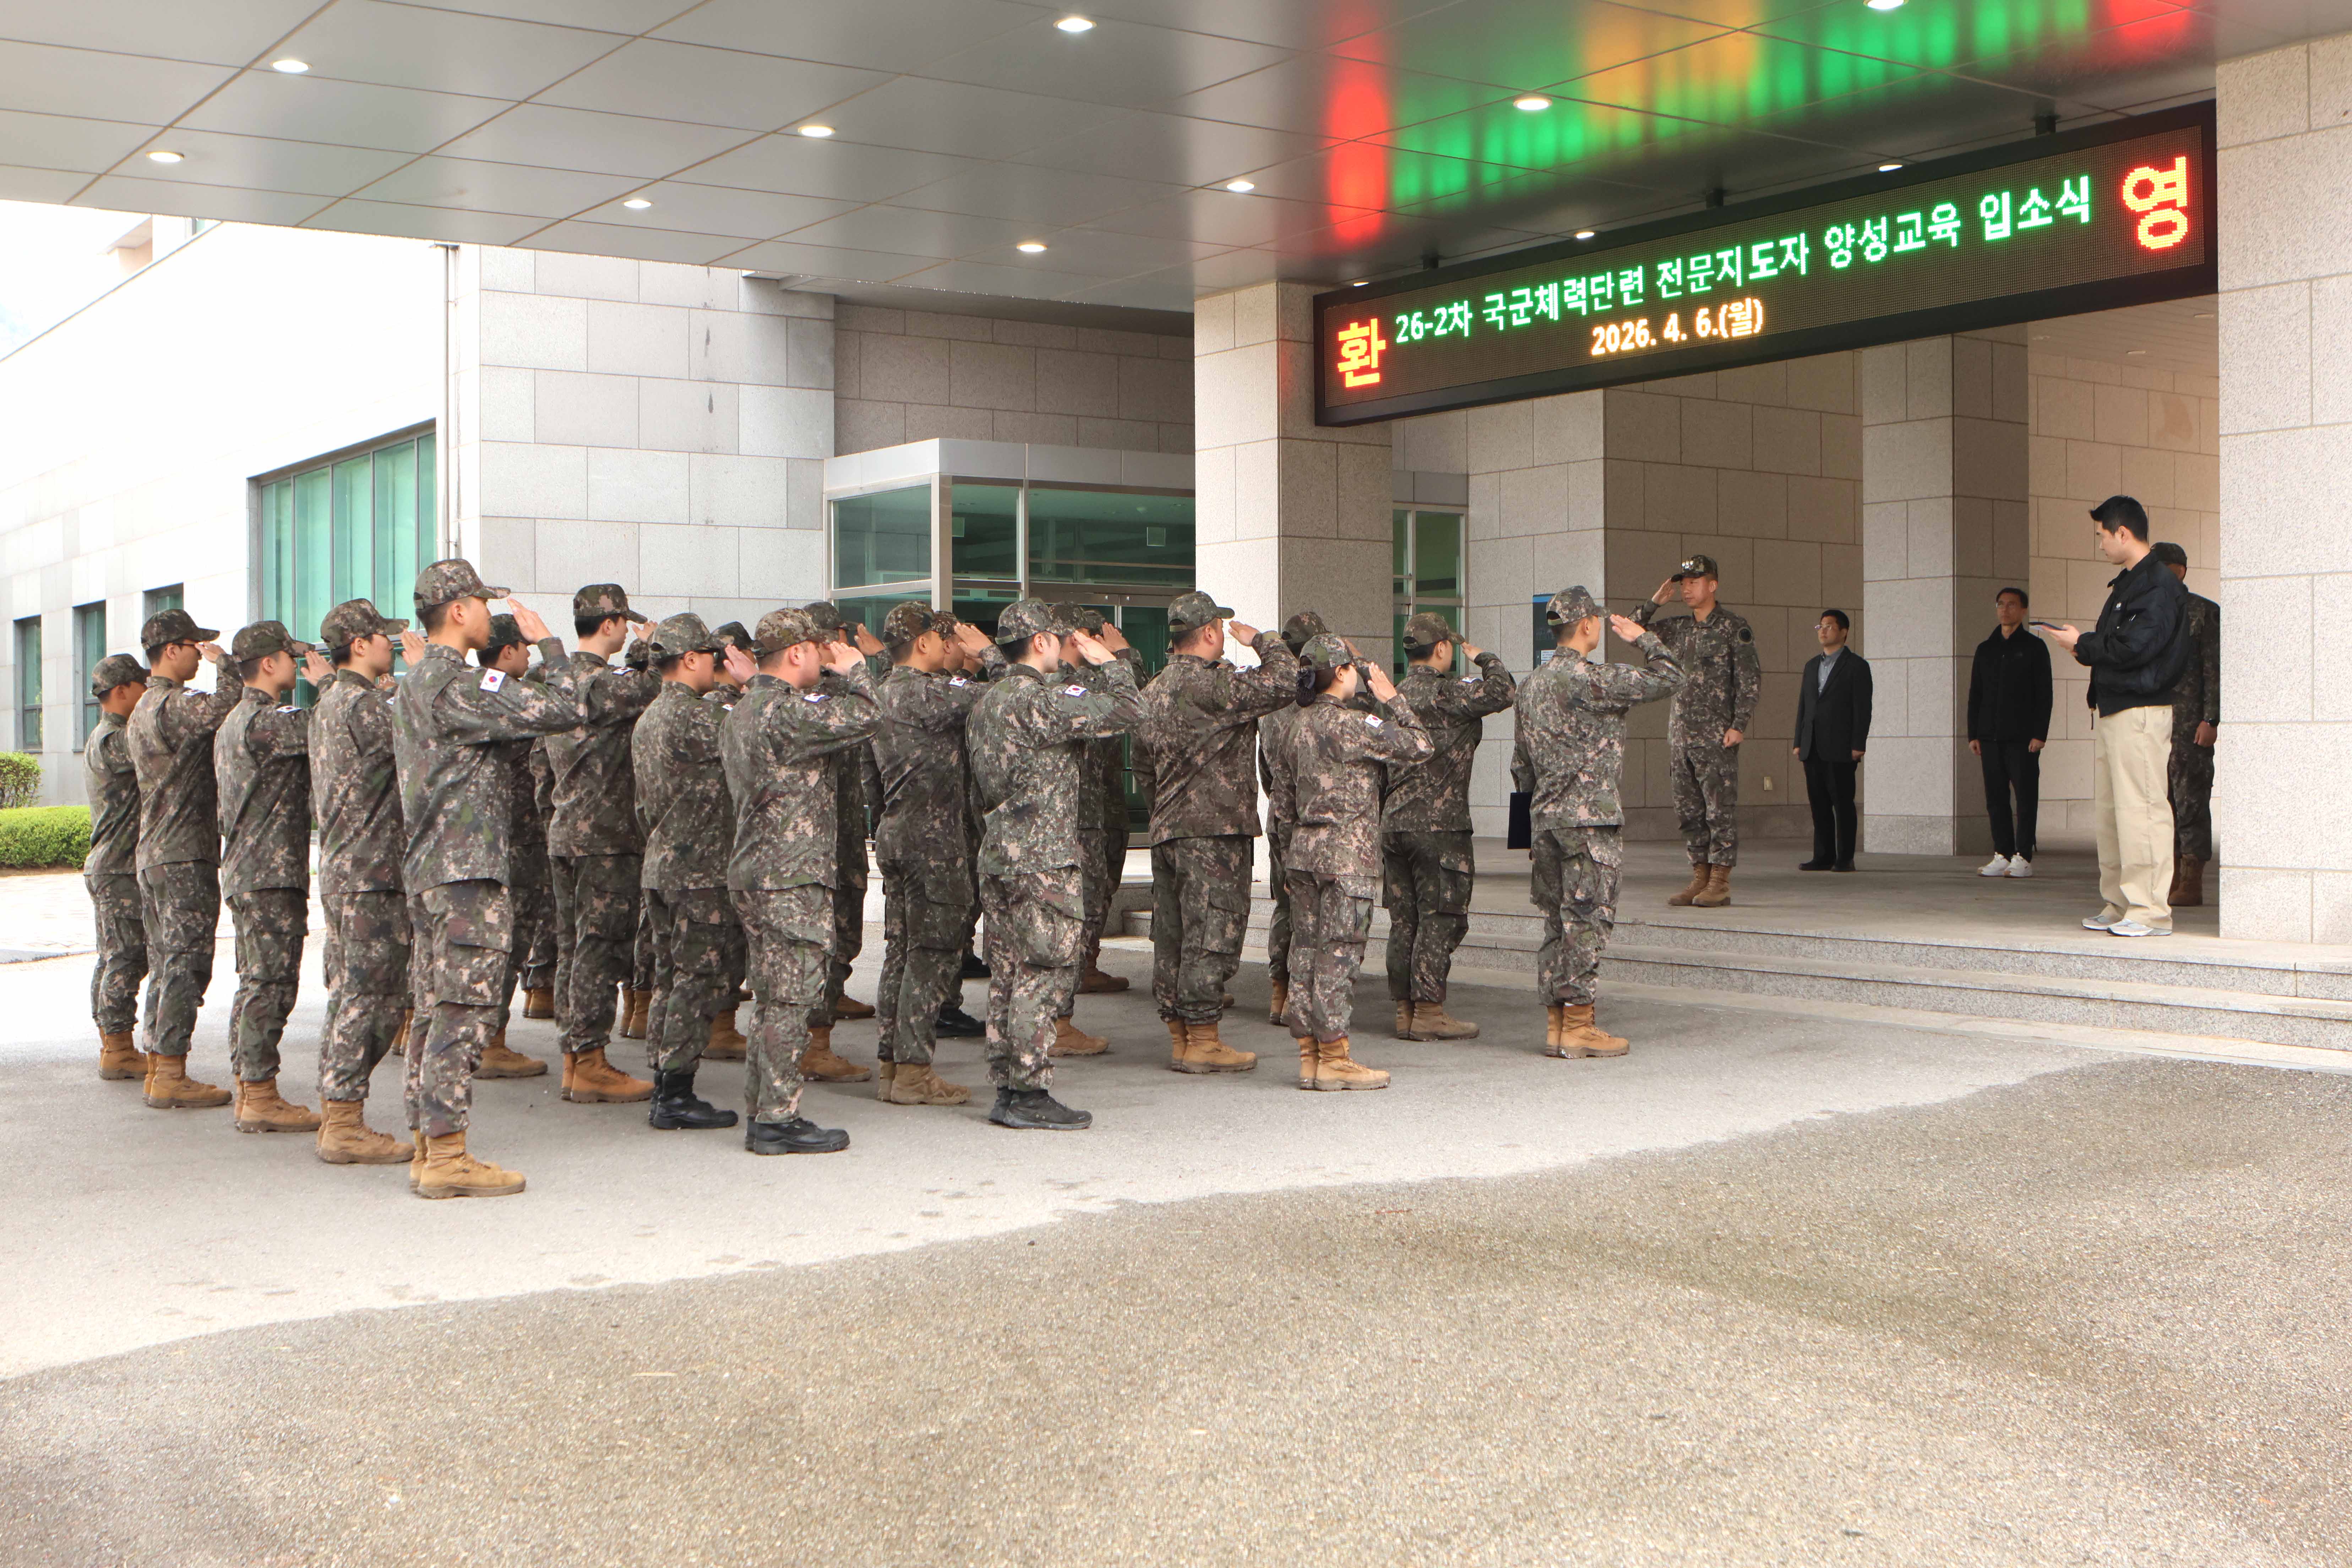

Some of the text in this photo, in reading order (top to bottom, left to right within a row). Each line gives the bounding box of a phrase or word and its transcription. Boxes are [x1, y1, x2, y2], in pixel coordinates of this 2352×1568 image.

[2120, 156, 2189, 251] 영
[1396, 175, 2089, 343] 26-2차 국군체력단련 전문지도자 양성교육 입소식
[1337, 318, 1387, 388] 환
[1591, 297, 1763, 355] 2026. 4. 6.(월)
